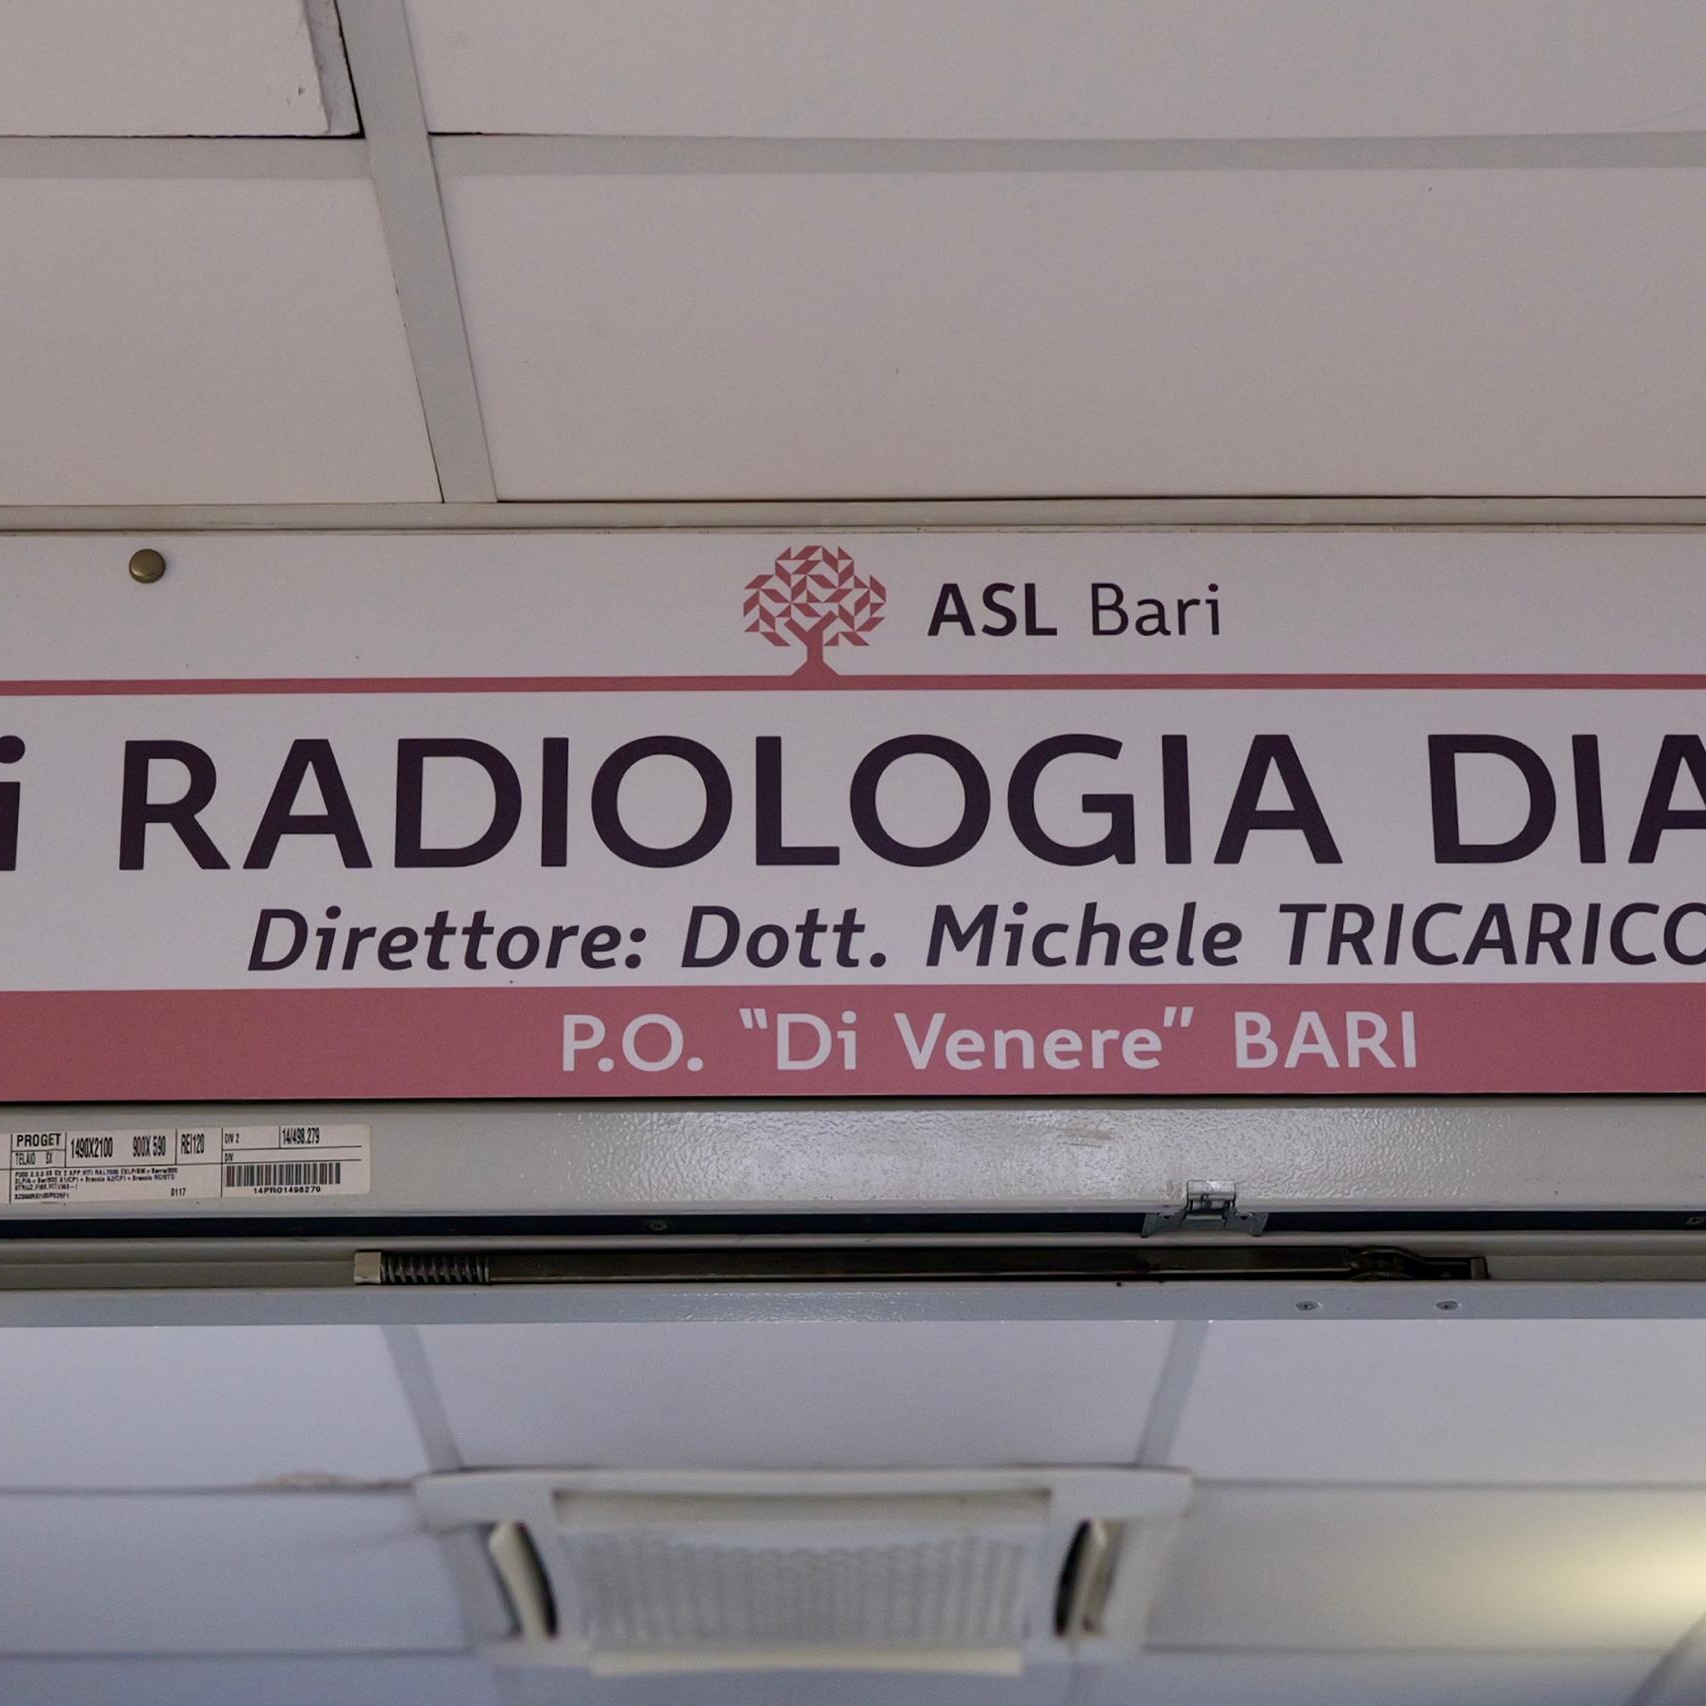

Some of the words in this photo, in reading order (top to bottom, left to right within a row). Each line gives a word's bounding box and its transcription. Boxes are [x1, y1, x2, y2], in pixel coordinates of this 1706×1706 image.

[928, 582, 1058, 637] ASL
[1091, 582, 1222, 637] Bari
[118, 733, 1343, 871] RADIOLOGIA
[247, 905, 647, 972] Direttore:
[681, 905, 887, 969] Dott.
[926, 901, 1243, 968] Michele
[563, 1013, 704, 1072] P.O.
[1234, 1011, 1416, 1070] BARI
[15, 1152, 36, 1165] TELAIO
[16, 1133, 62, 1147] PROGET
[70, 1136, 113, 1159] 1490X2100
[181, 1133, 205, 1155] REI120
